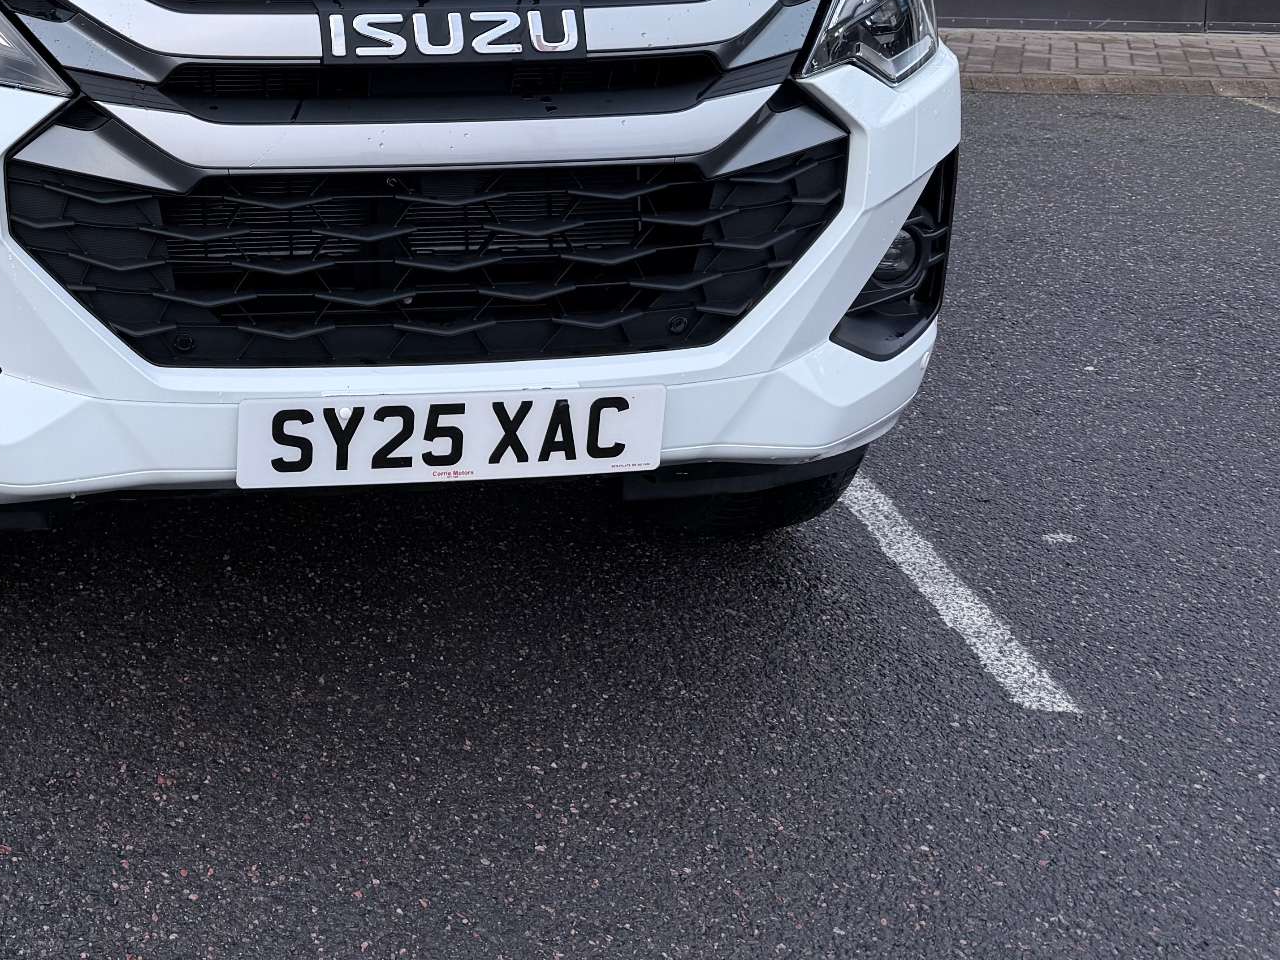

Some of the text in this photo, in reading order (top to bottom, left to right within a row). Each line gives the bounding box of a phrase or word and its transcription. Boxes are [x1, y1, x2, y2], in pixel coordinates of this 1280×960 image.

[328, 9, 579, 57] ISUZU
[270, 396, 631, 473] SY25 XAC
